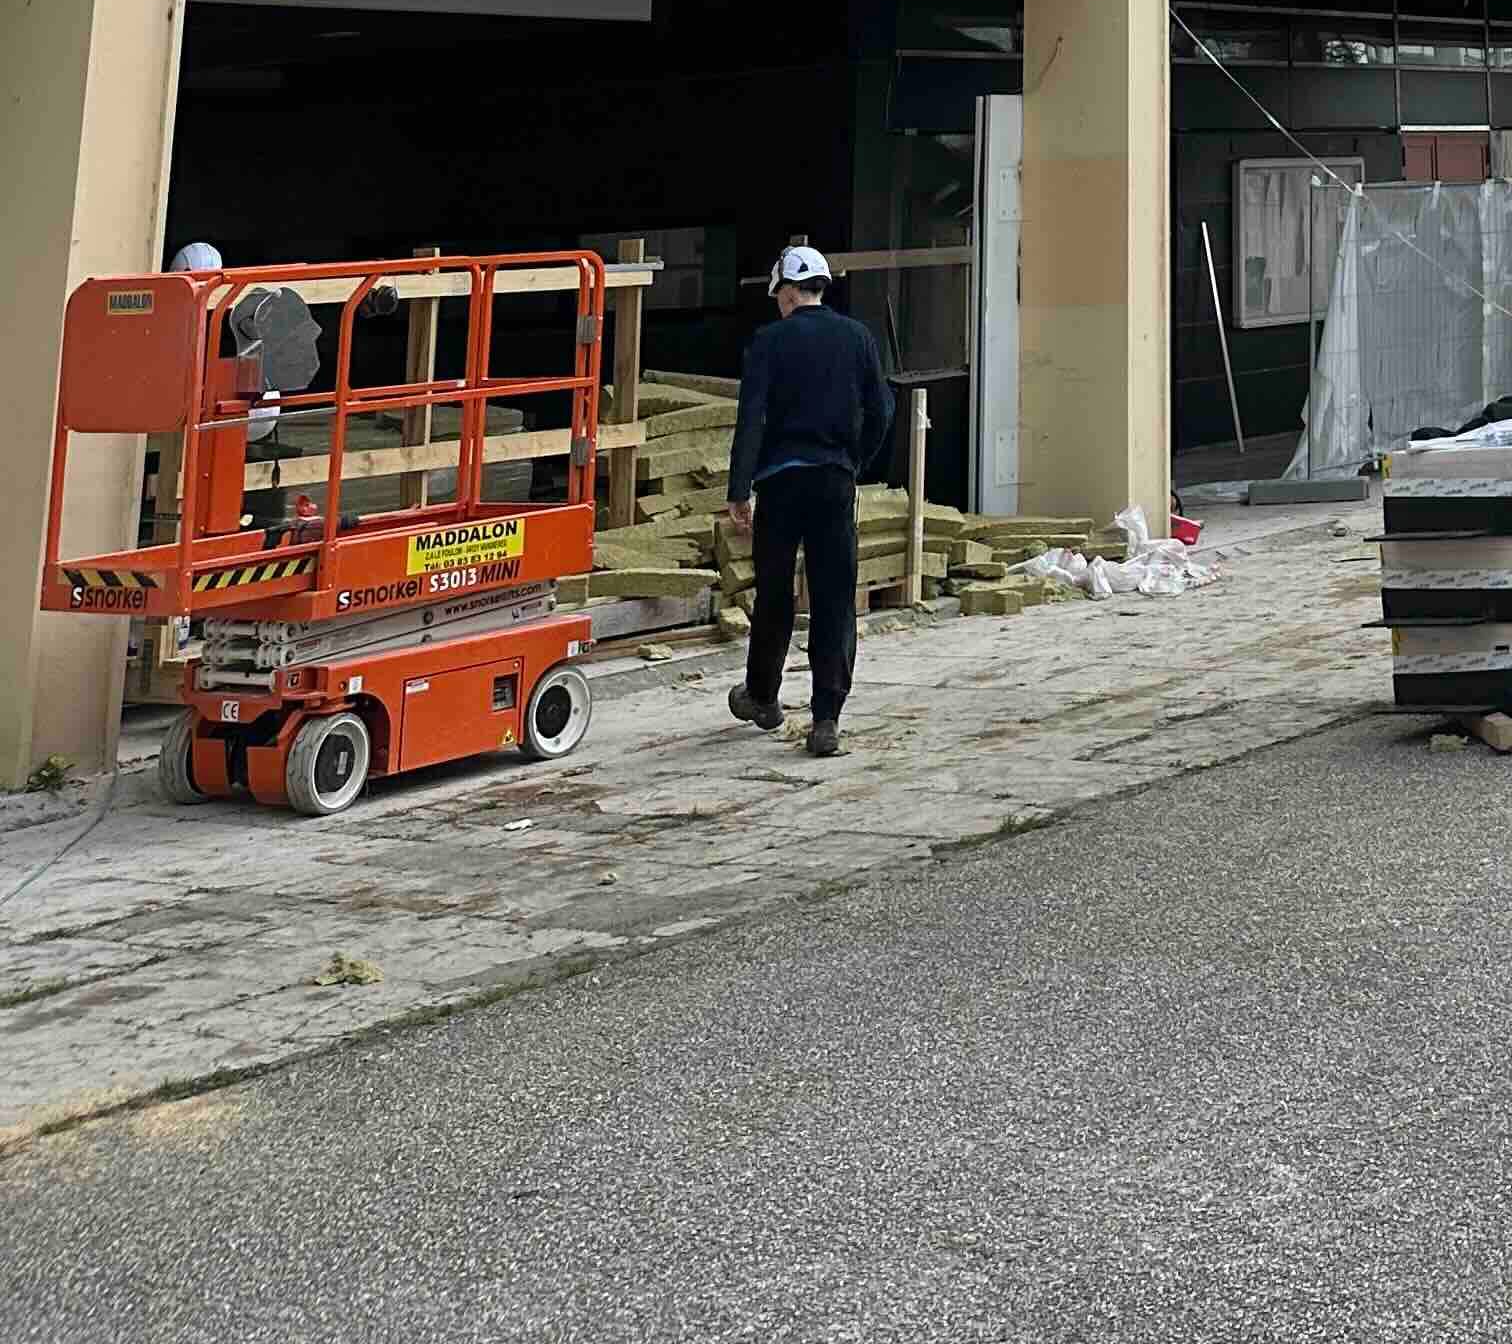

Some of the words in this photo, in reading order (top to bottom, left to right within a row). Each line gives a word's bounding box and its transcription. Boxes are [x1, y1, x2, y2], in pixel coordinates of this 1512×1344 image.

[416, 520, 518, 552] MADDALON
[85, 587, 148, 609] snorkel
[353, 577, 423, 607] snorkel
[429, 567, 478, 593] S3013
[479, 559, 521, 584] MINI
